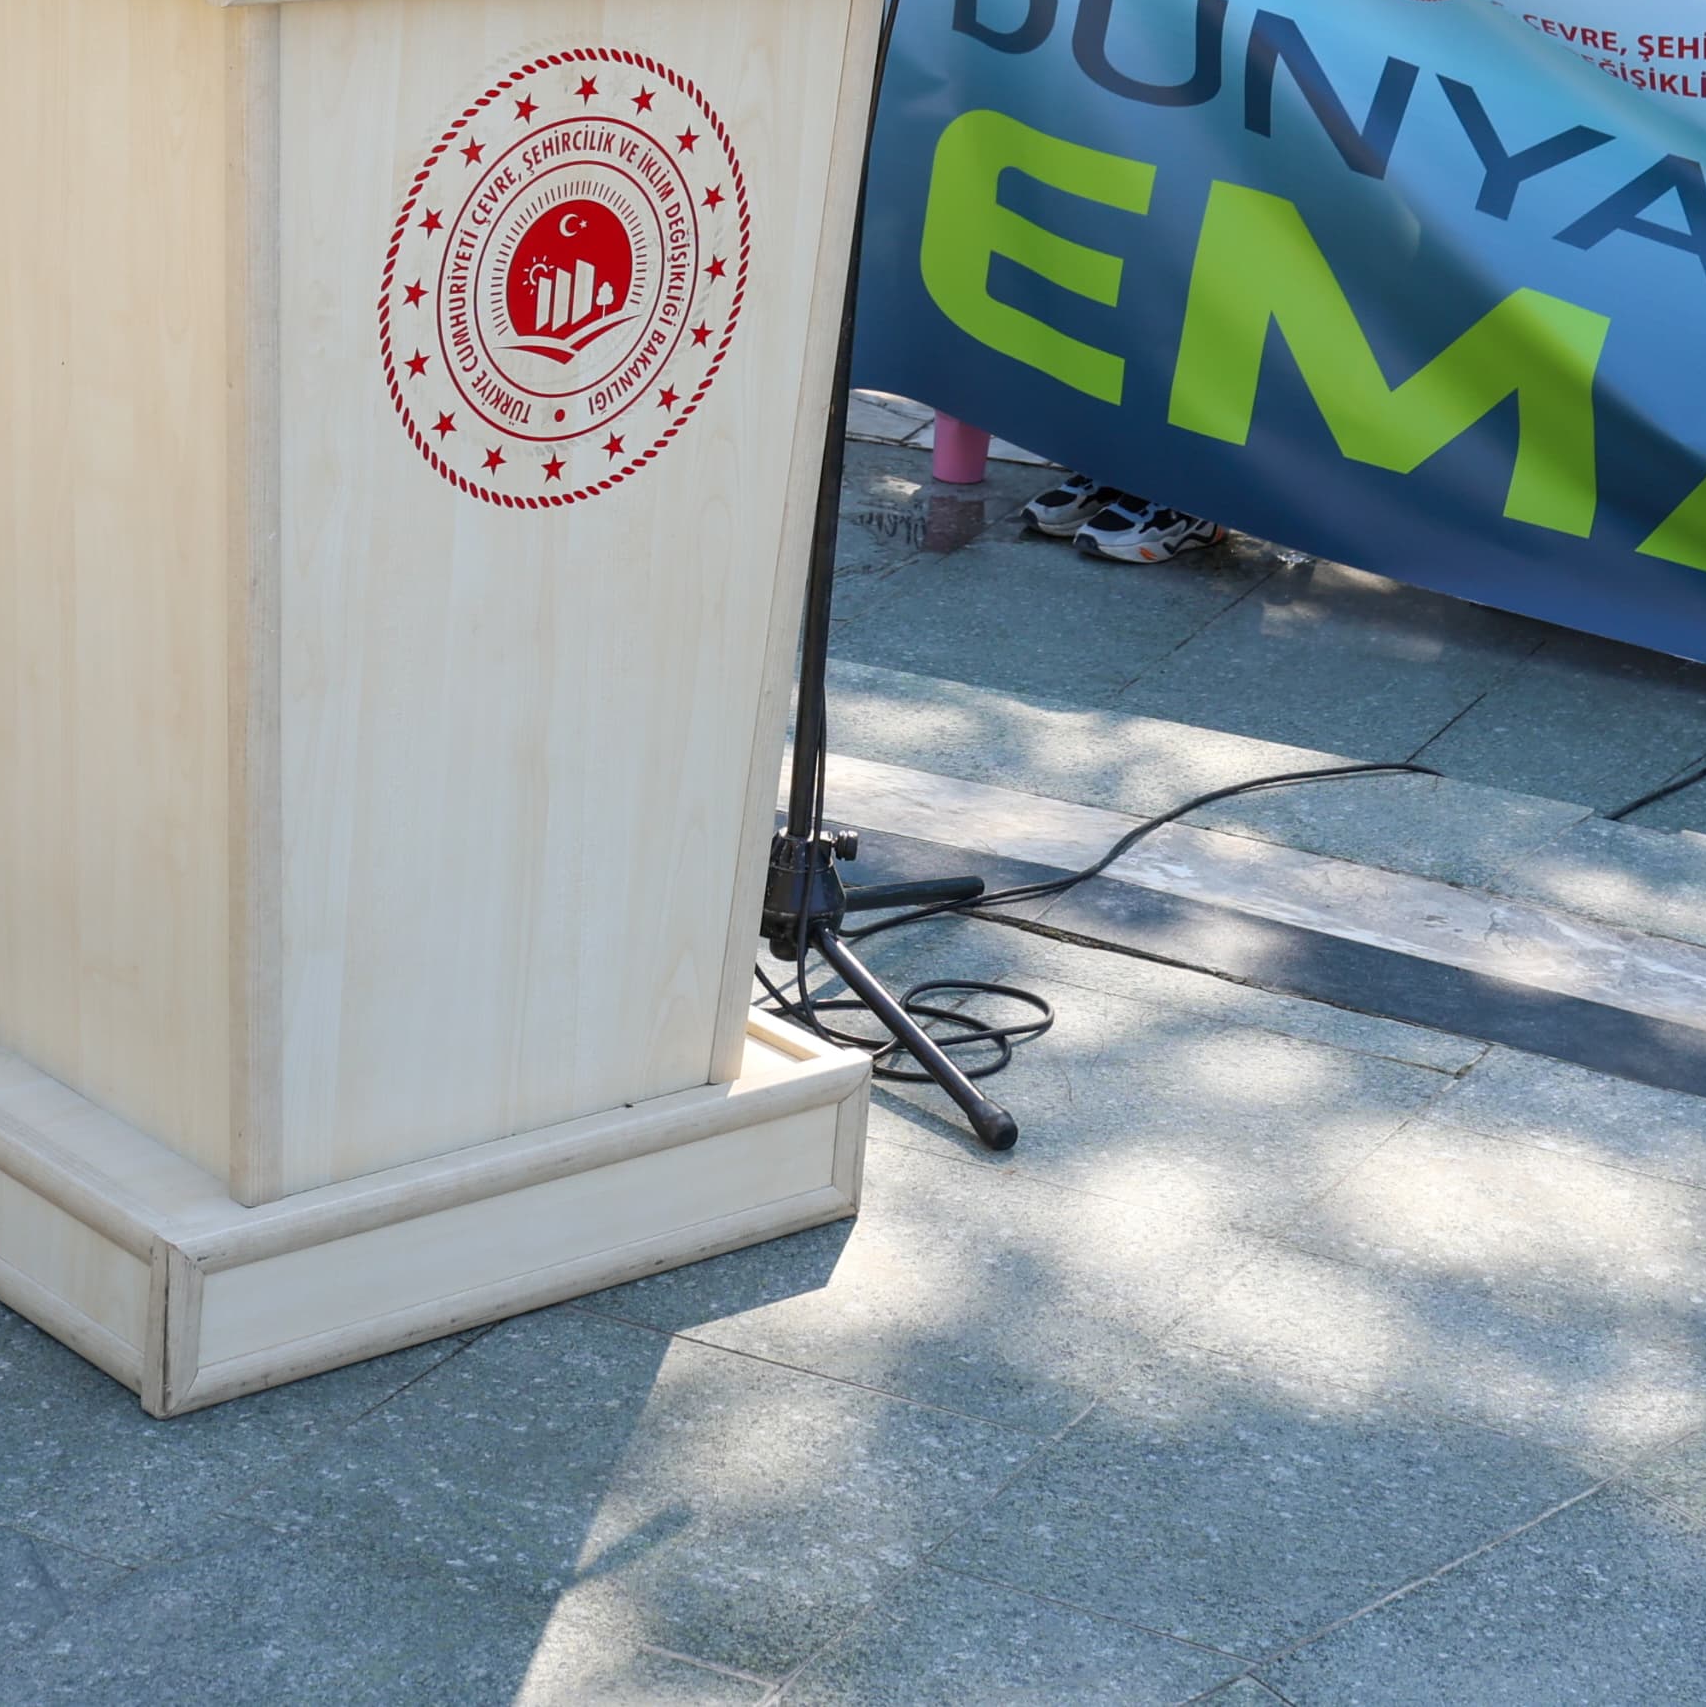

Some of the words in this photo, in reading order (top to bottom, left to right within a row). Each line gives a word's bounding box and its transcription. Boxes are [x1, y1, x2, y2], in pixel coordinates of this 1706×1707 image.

[521, 123, 616, 177] ŞEHİRCİLİK
[619, 136, 640, 165] VE
[636, 146, 676, 205] İKLİM
[470, 166, 524, 227] ÇEVRE,
[662, 198, 695, 328] DEĞİŞİKLİĞİ
[447, 228, 480, 370] CUMHURİYETİ
[471, 369, 532, 426] TÜRKİYE
[587, 327, 668, 418] BAKANLIĞI
